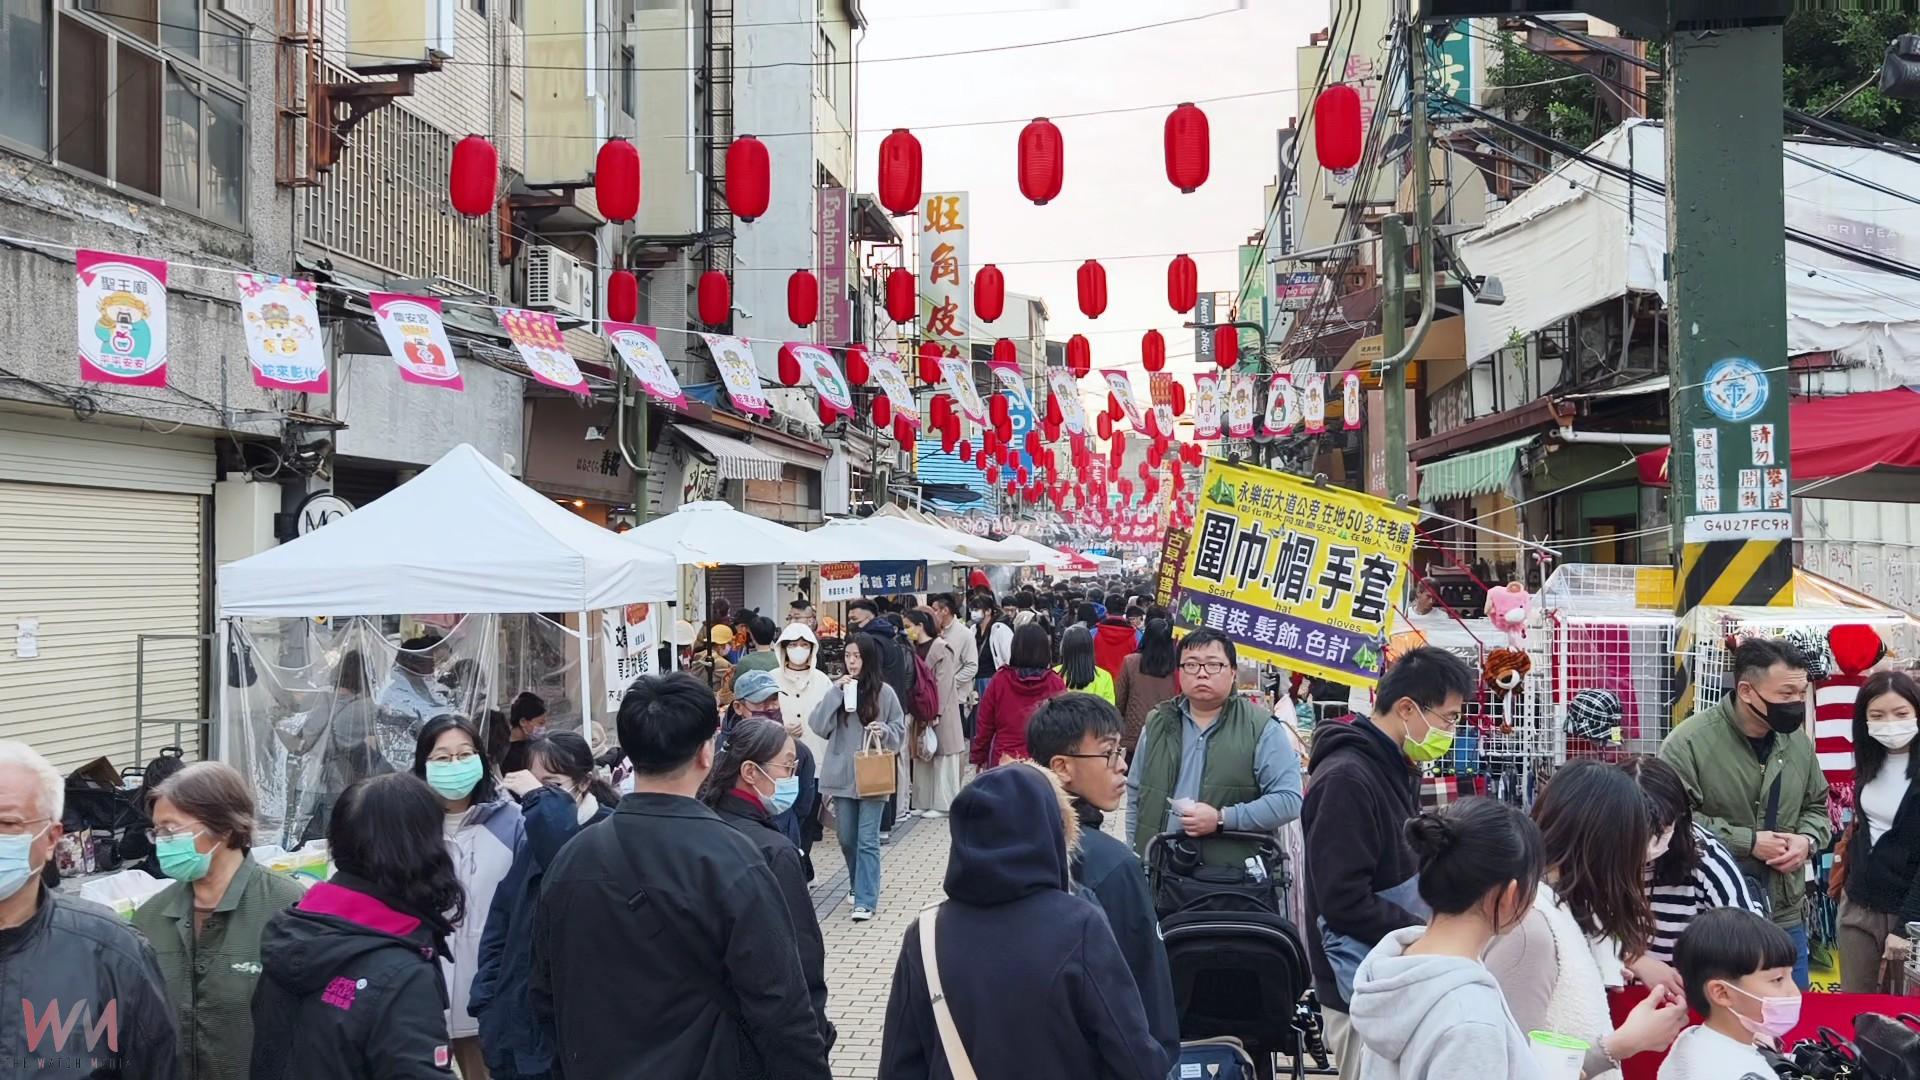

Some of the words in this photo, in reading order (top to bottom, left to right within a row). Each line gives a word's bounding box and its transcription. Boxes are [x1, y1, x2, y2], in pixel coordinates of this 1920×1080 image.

[822, 196, 840, 266] Fashion
[101, 275, 148, 296] 聖王廟
[822, 276, 840, 340] Market
[262, 363, 317, 381] 蛇來彰化
[1752, 425, 1771, 464] 請勿
[1208, 585, 1235, 598] Scarf
[1275, 602, 1292, 613] hat
[1327, 616, 1361, 632] gloves
